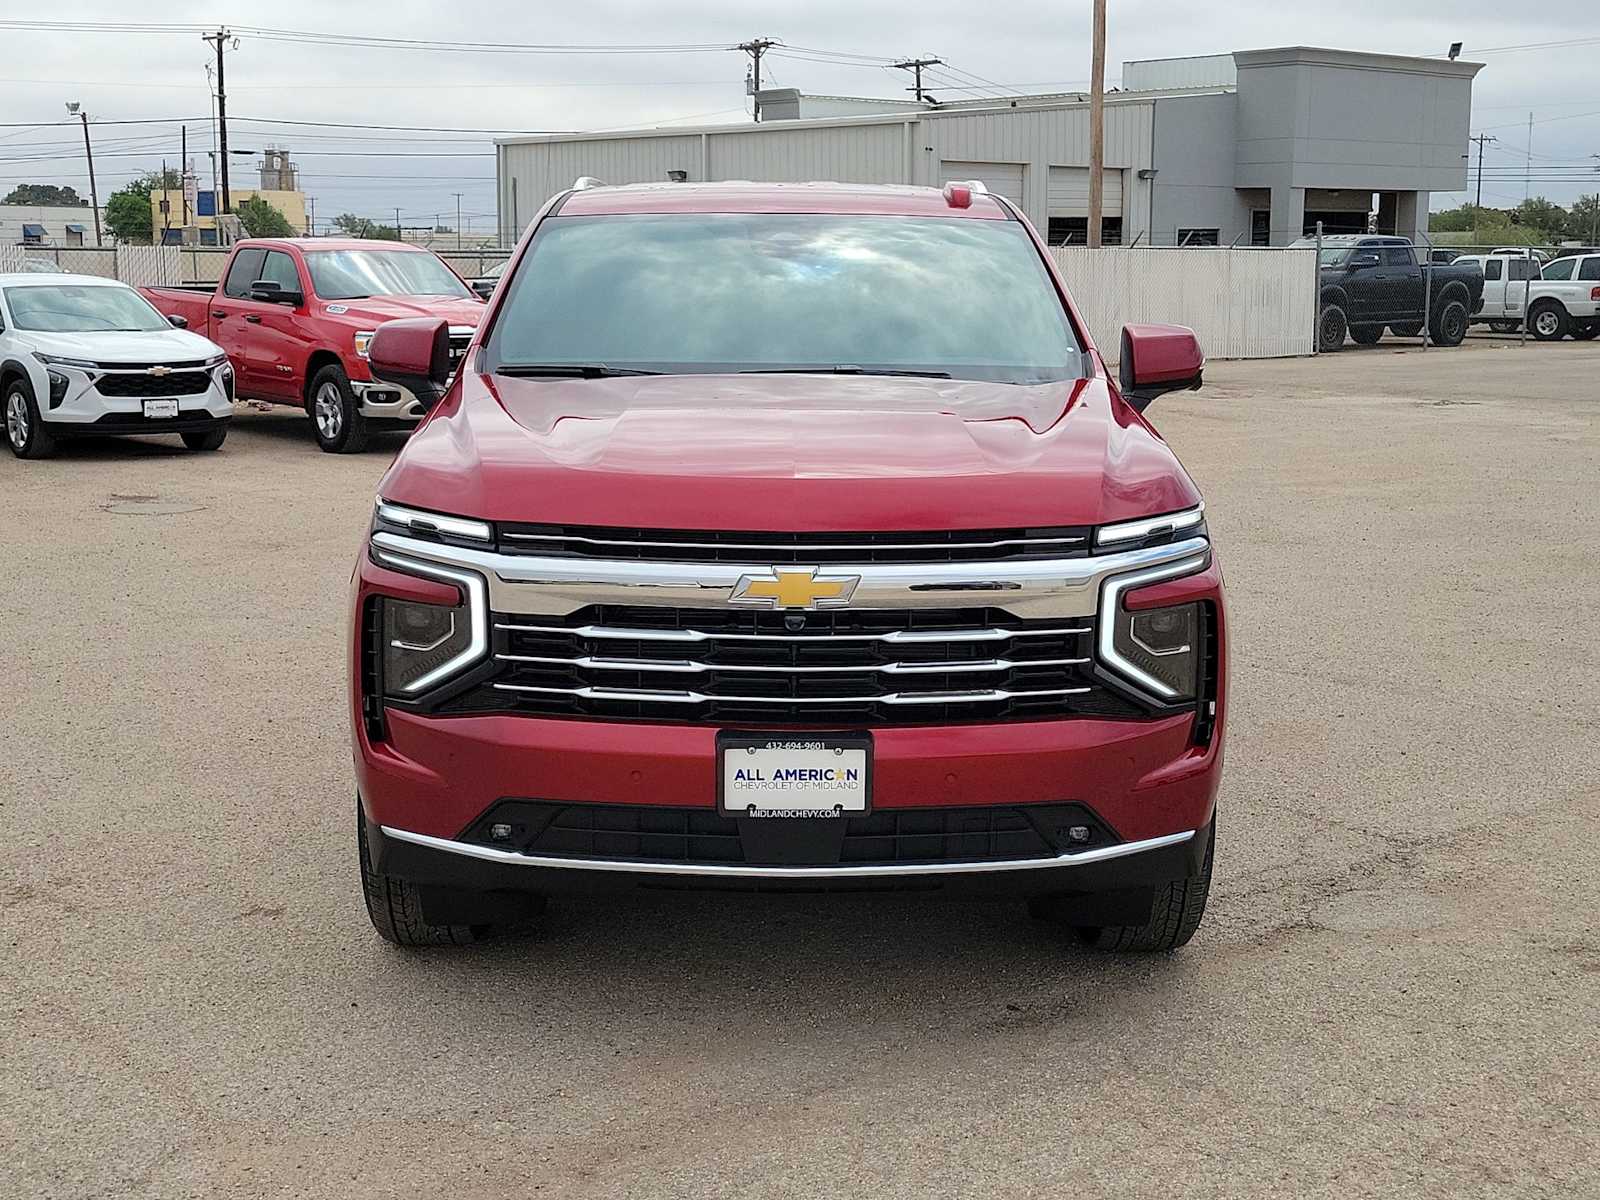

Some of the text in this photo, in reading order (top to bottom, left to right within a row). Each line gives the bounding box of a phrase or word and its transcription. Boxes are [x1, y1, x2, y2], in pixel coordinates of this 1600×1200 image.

[765, 742, 825, 750] 432-694-9601
[734, 768, 858, 781] ALL AMERICN
[734, 781, 858, 790] CHEVROLET OF MIDLAND
[749, 809, 840, 818] MIDLANDCHEVY.COM
